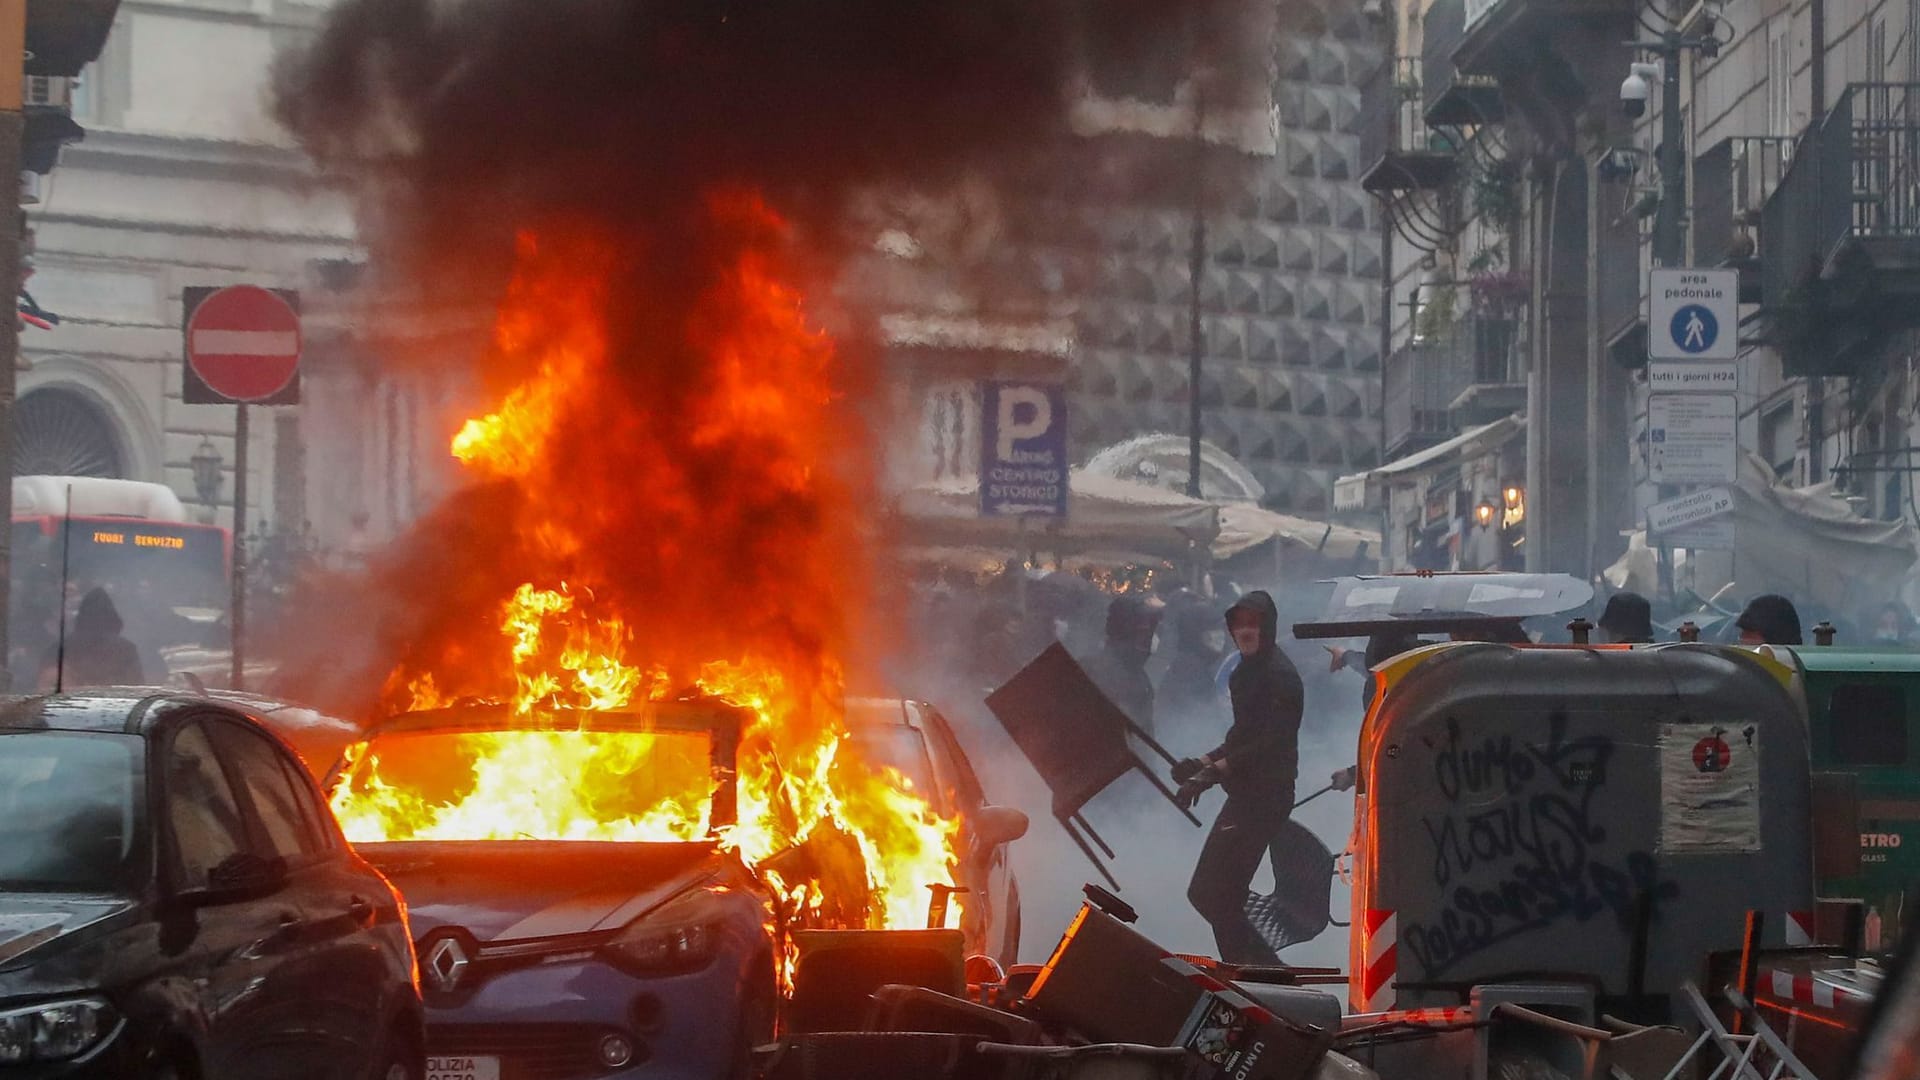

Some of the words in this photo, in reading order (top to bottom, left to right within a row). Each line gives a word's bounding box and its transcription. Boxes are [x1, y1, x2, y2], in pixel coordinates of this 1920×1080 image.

[1680, 275, 1707, 284] area
[1665, 287, 1722, 299] pedonale
[1652, 372, 1674, 380] tutti
[1683, 372, 1710, 382] giorni
[1713, 372, 1735, 380] H24
[997, 386, 1051, 462] P
[135, 534, 184, 549] SERVIZIO
[1860, 833, 1901, 847] ETRO
[1861, 854, 1887, 863] GLASS
[425, 1059, 475, 1071] OLIZIA
[1235, 1041, 1265, 1080] UMID
